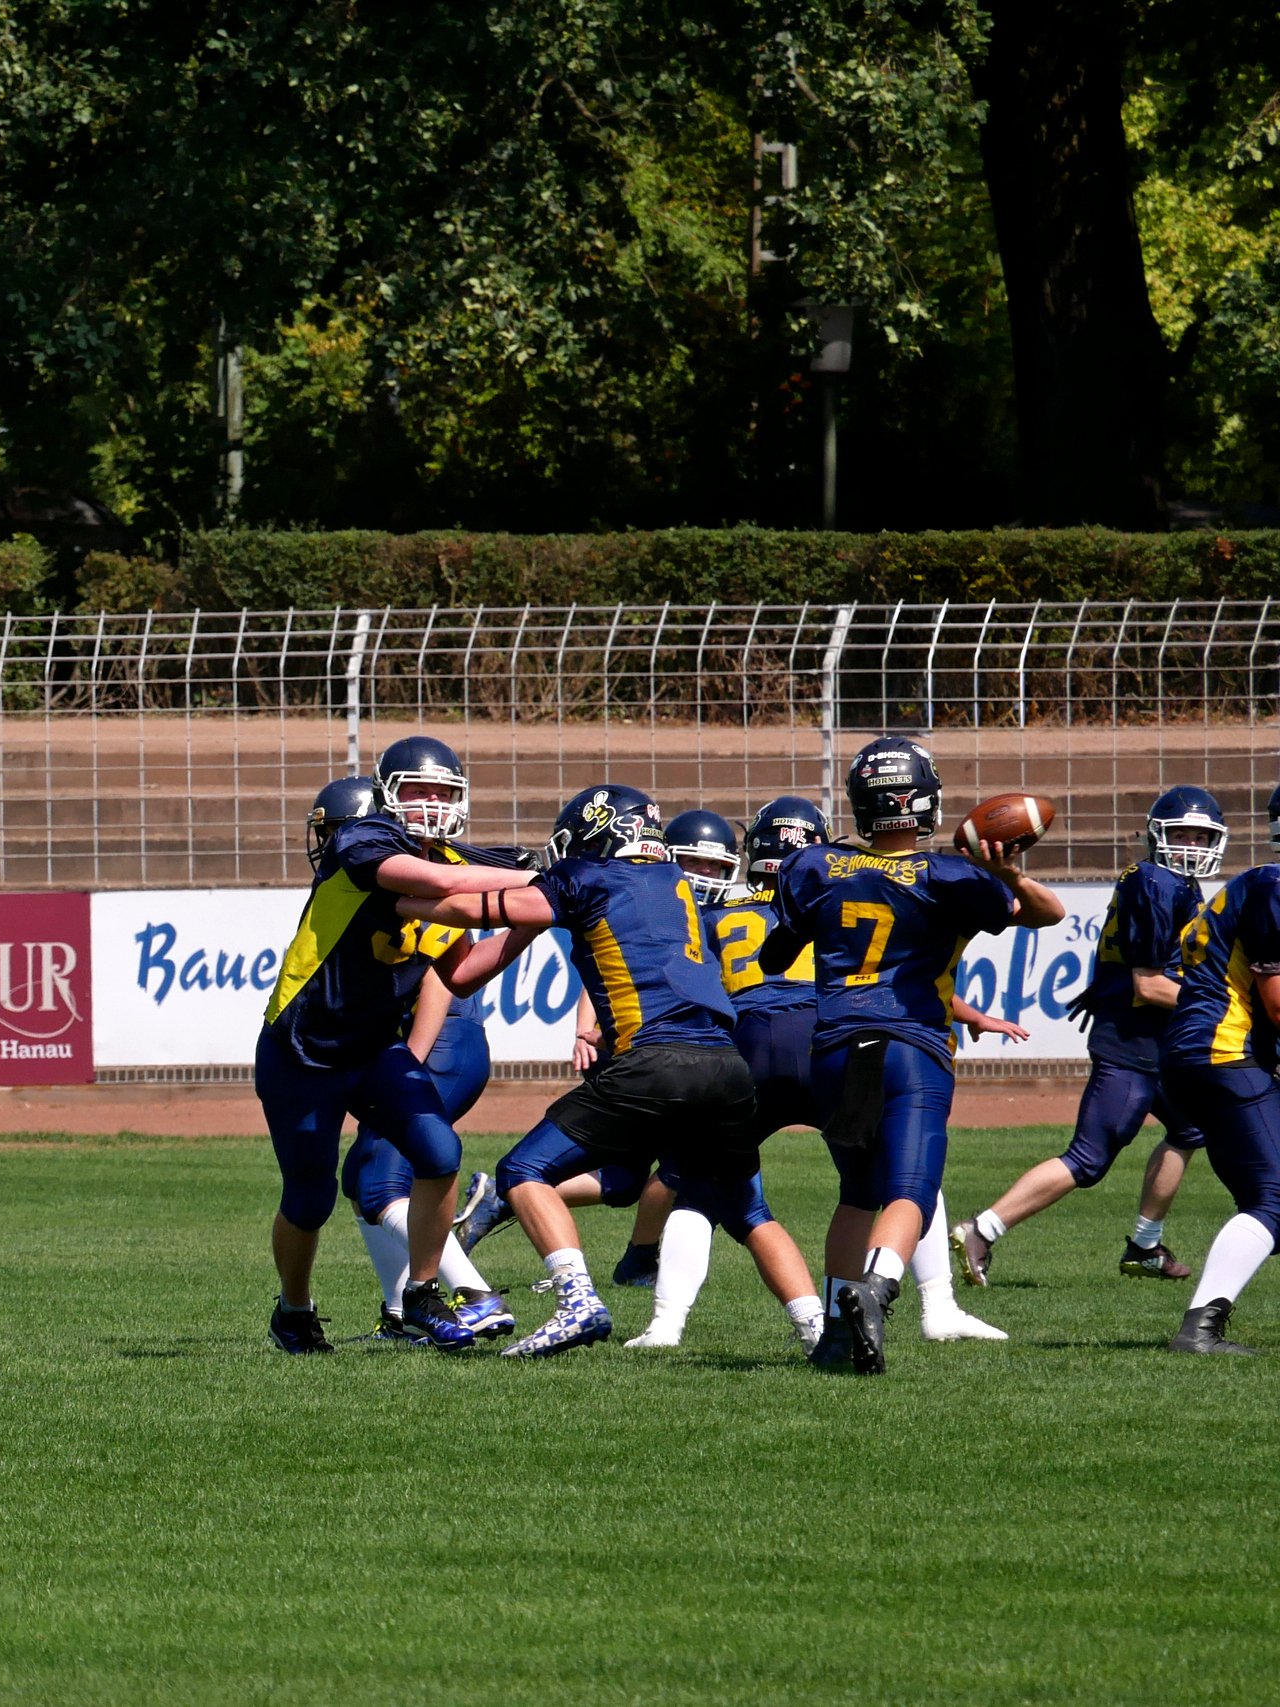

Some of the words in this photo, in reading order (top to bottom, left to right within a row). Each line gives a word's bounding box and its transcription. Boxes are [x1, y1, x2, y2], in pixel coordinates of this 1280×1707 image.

[868, 775, 912, 787] HORNETS
[875, 819, 916, 831] Riddell
[847, 854, 899, 875] HORNETS
[675, 879, 704, 964] 1
[841, 901, 895, 986] 7
[135, 921, 287, 1006] Baue
[0, 1040, 74, 1060] Hanau
